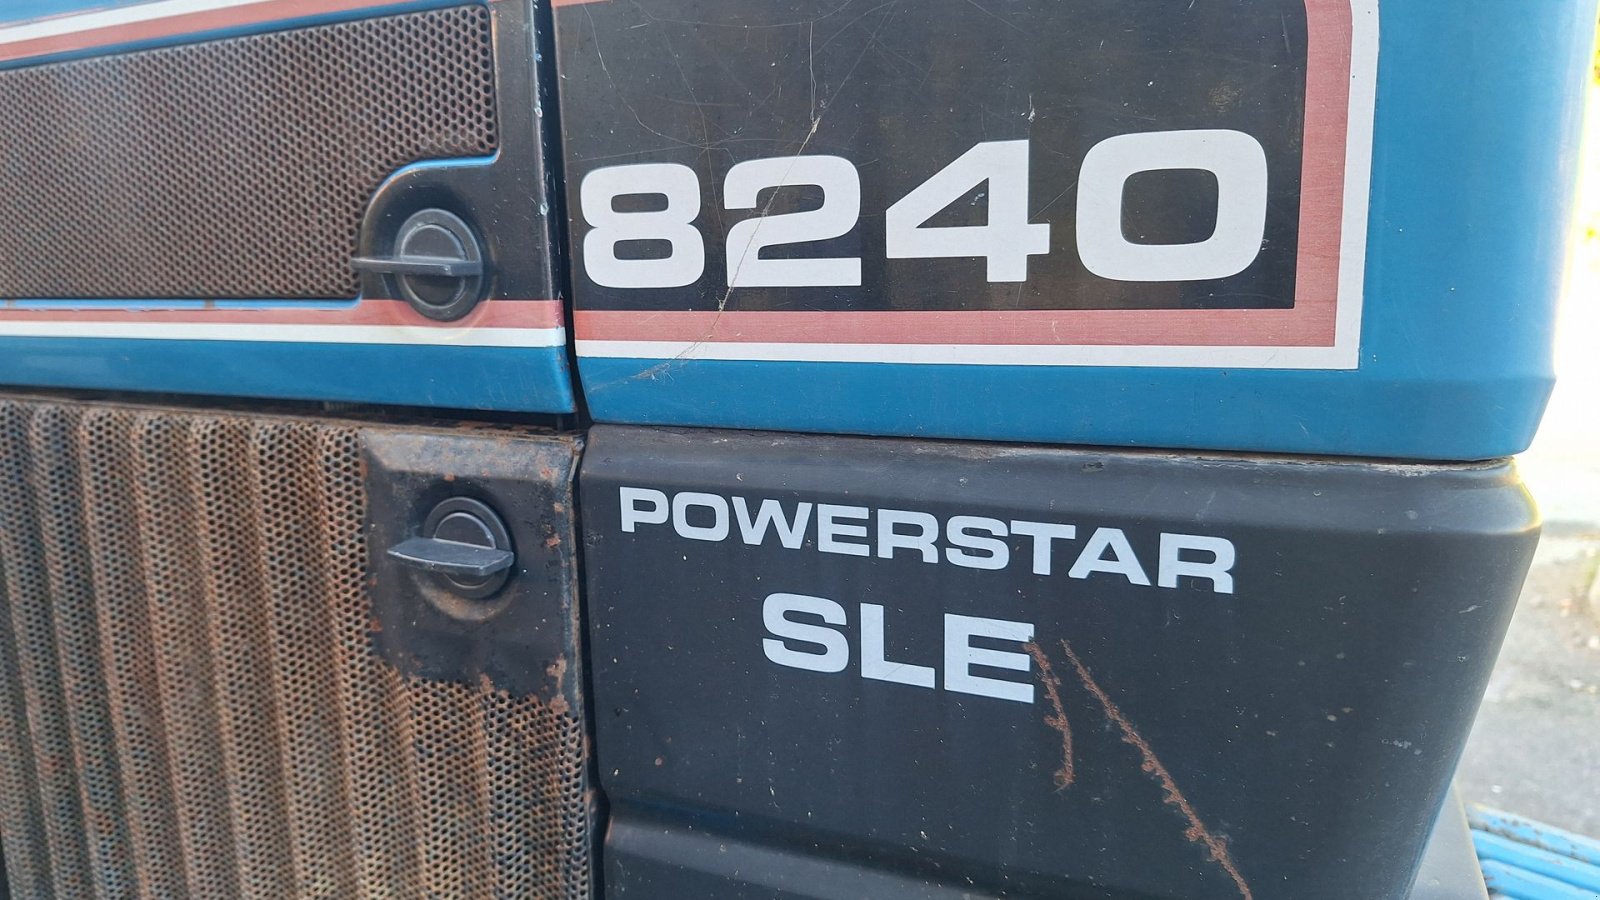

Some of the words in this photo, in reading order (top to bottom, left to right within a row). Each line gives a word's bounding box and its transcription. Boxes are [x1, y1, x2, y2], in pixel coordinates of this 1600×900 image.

[580, 129, 1268, 289] 8240
[620, 487, 1236, 595] POWERSTAR
[763, 593, 1035, 704] SLE
